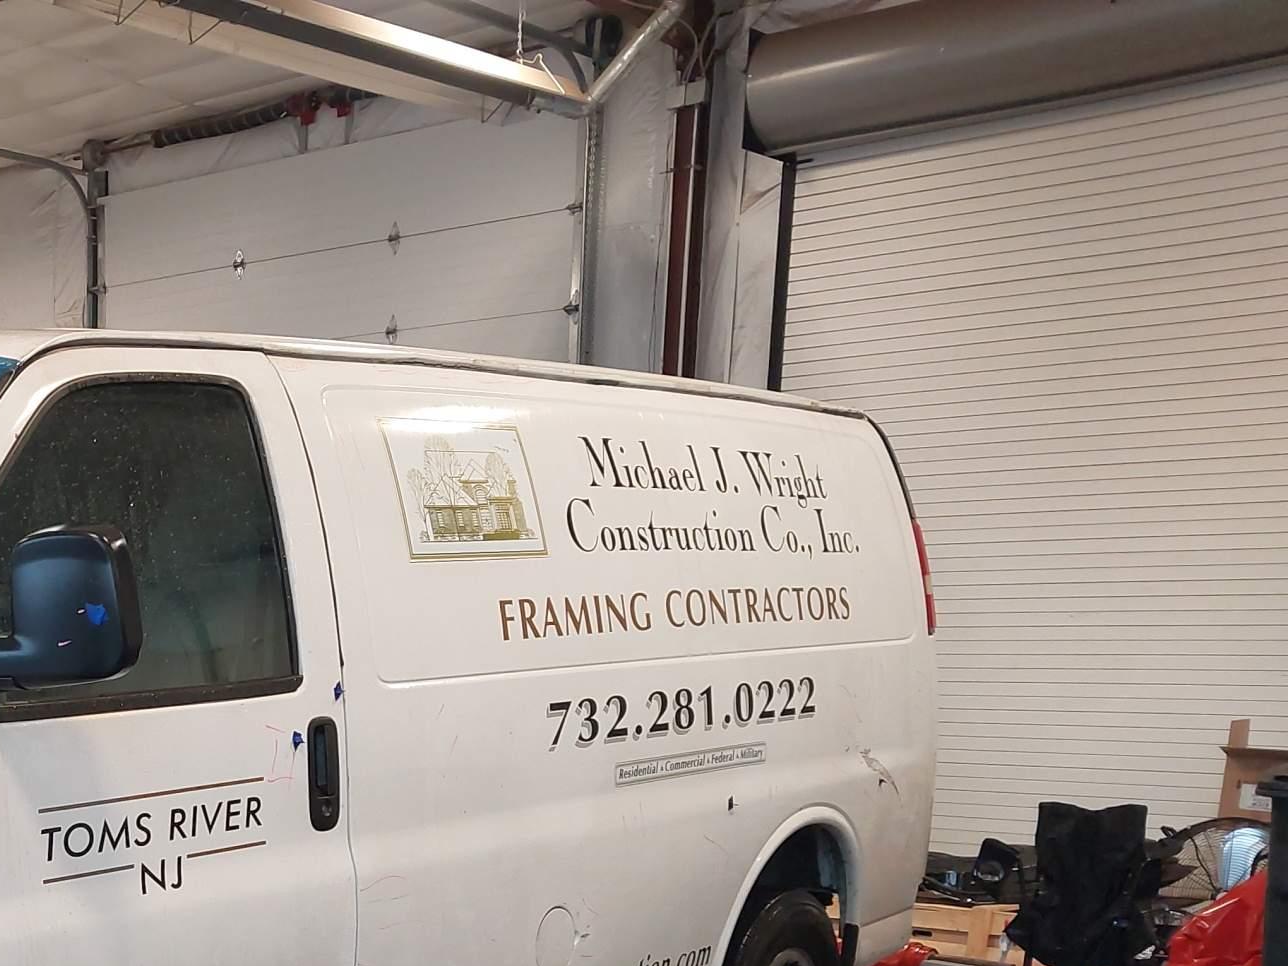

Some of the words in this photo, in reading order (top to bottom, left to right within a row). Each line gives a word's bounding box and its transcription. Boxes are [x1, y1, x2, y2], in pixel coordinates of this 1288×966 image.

[578, 436, 706, 495] Michael
[709, 446, 740, 494] J.
[741, 451, 828, 508] Wright
[565, 498, 755, 554] Construction
[759, 506, 814, 560] Co.,
[815, 508, 861, 554] Inc.
[499, 592, 653, 642] FRAMING
[665, 586, 851, 628] CONTRACTORS
[546, 676, 818, 752] 732.281.0222
[618, 763, 659, 780] Residential
[664, 754, 706, 773] Commercial
[711, 749, 735, 764] Federal
[740, 748, 763, 760] Military
[41, 811, 153, 862] TOMS
[169, 796, 264, 842] RIVER
[140, 855, 184, 896] NJ
